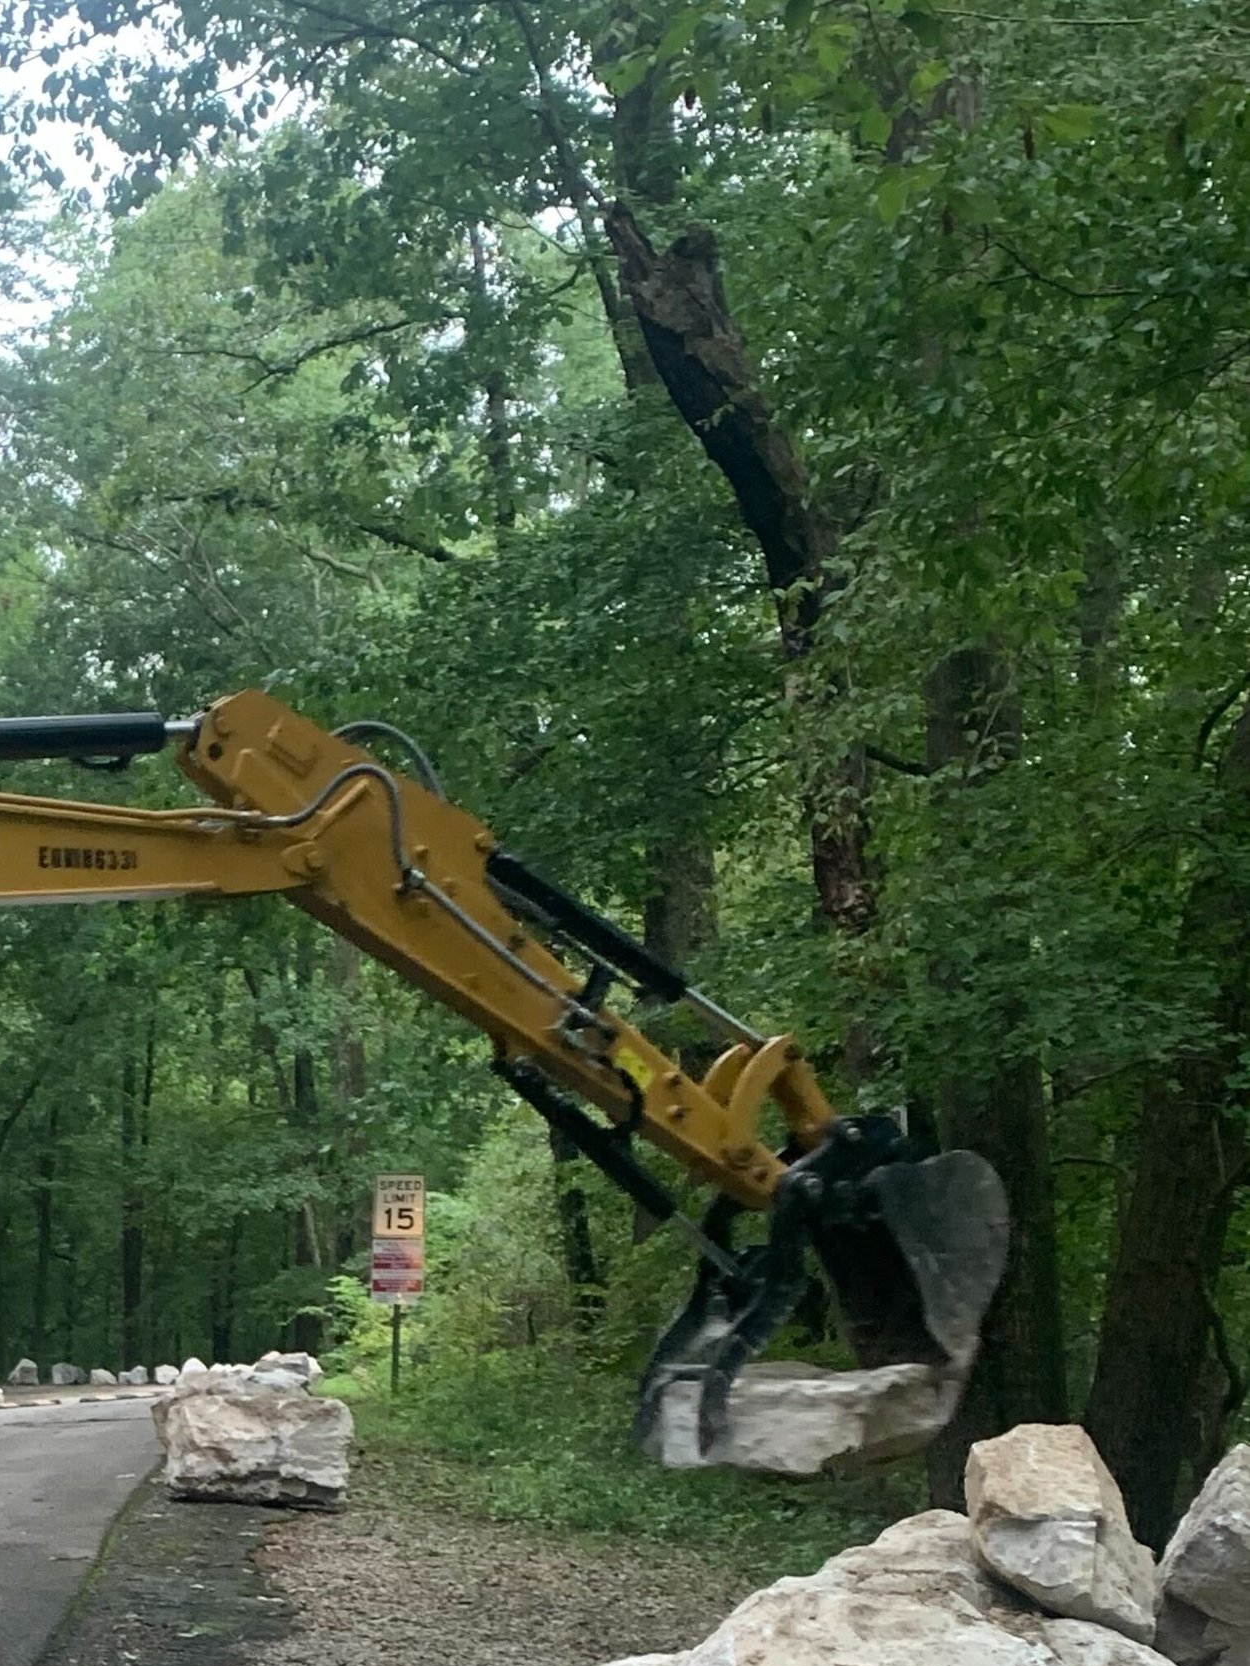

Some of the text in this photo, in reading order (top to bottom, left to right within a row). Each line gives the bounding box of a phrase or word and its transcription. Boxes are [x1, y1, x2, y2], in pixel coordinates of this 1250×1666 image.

[379, 1181, 422, 1190] SPEED
[383, 1193, 416, 1204] LIMIT
[384, 1208, 415, 1230] 15
